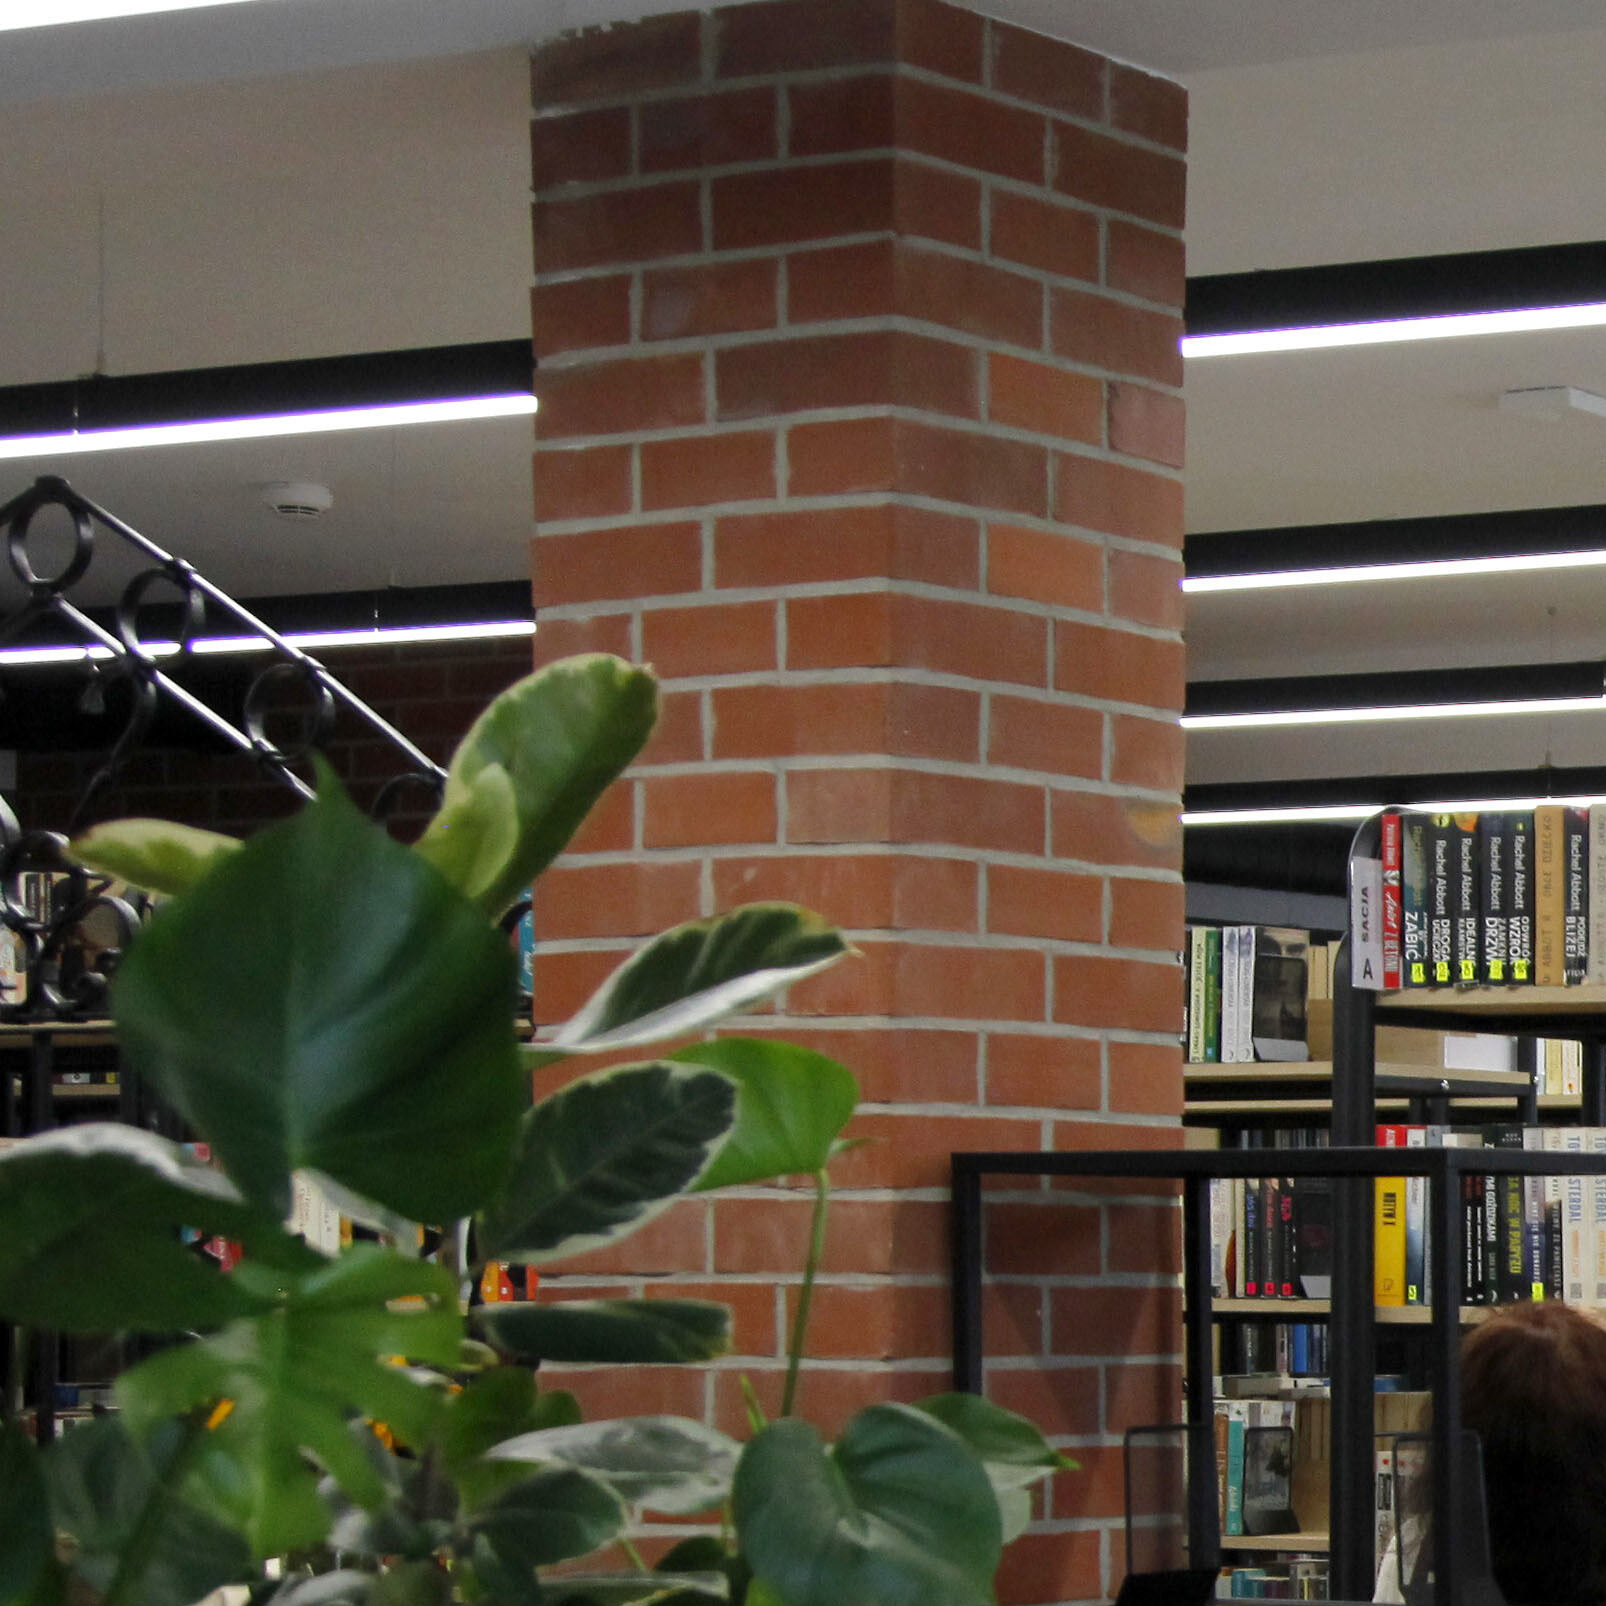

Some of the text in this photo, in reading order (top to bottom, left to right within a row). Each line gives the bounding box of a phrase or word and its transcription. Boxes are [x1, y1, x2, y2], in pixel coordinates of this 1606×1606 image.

[1436, 840, 1446, 915] Rachel Abbott
[1461, 838, 1472, 910] Rachel Abbott
[1490, 837, 1501, 909] Rachel Abbott
[1514, 835, 1525, 909] Rachel Abbott
[1570, 835, 1581, 910] Rachel Abbott
[1363, 958, 1374, 980] A
